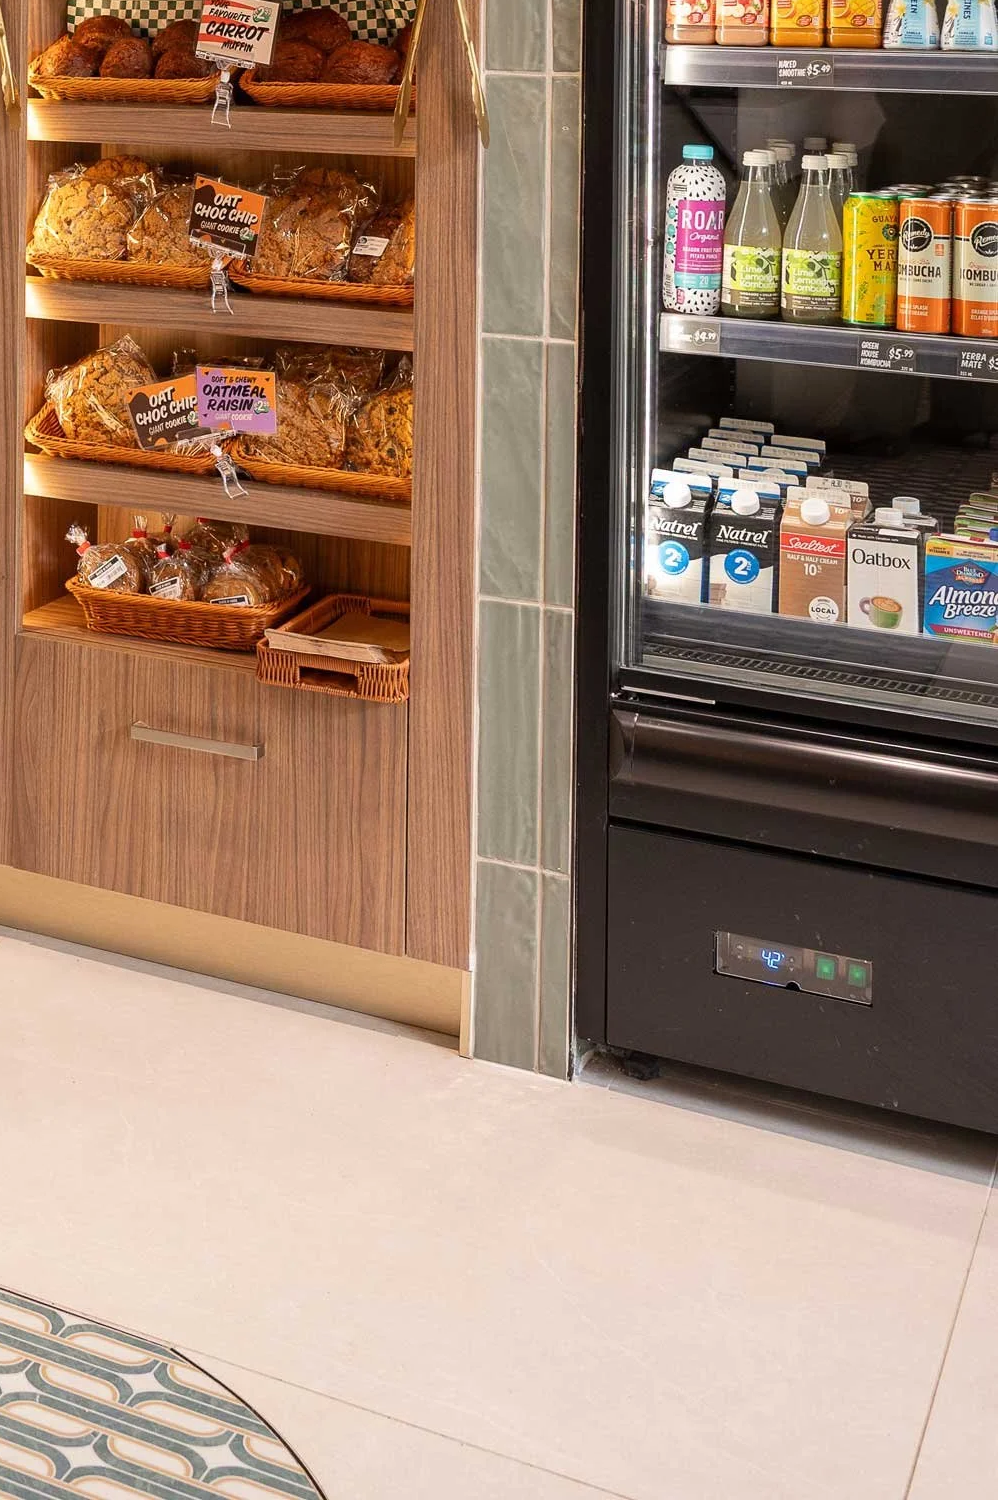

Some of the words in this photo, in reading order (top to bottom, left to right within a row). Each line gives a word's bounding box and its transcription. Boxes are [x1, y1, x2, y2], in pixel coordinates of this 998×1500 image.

[210, 0, 231, 10] YOUR
[208, 8, 251, 23] FAVOURITE
[206, 20, 270, 42] CARROT
[221, 40, 254, 53] MUFFIN
[778, 60, 797, 68] NAKED
[807, 64, 831, 76] $5.49
[214, 193, 242, 208] OAT
[194, 202, 227, 221] CHOC
[228, 208, 258, 226] CHIP
[682, 210, 724, 230] ROAR
[200, 220, 217, 230] GIANT
[217, 224, 240, 234] COOKIE
[904, 228, 930, 242] Remedy
[794, 268, 814, 276] Lime
[861, 341, 880, 350] GREEN
[888, 348, 914, 360] $5.99
[861, 350, 879, 358] HOUSE
[961, 352, 986, 362] YERBA
[860, 358, 891, 368] KOMBUCHA
[960, 360, 983, 369] MATE
[149, 386, 175, 408] OAT
[202, 384, 266, 398] OATMEAL
[207, 398, 254, 412] RAISIN
[135, 404, 168, 426] CHOC
[148, 424, 164, 436] GIANT
[165, 416, 187, 429] COOKIE
[650, 517, 702, 536] Natrel
[717, 524, 772, 544] Natrel
[789, 537, 837, 554] Sealtest
[852, 548, 911, 570] Oatbox
[956, 570, 984, 578] DIAMOND
[944, 604, 996, 619] Breeze
[944, 627, 992, 639] UNSWEETENED
